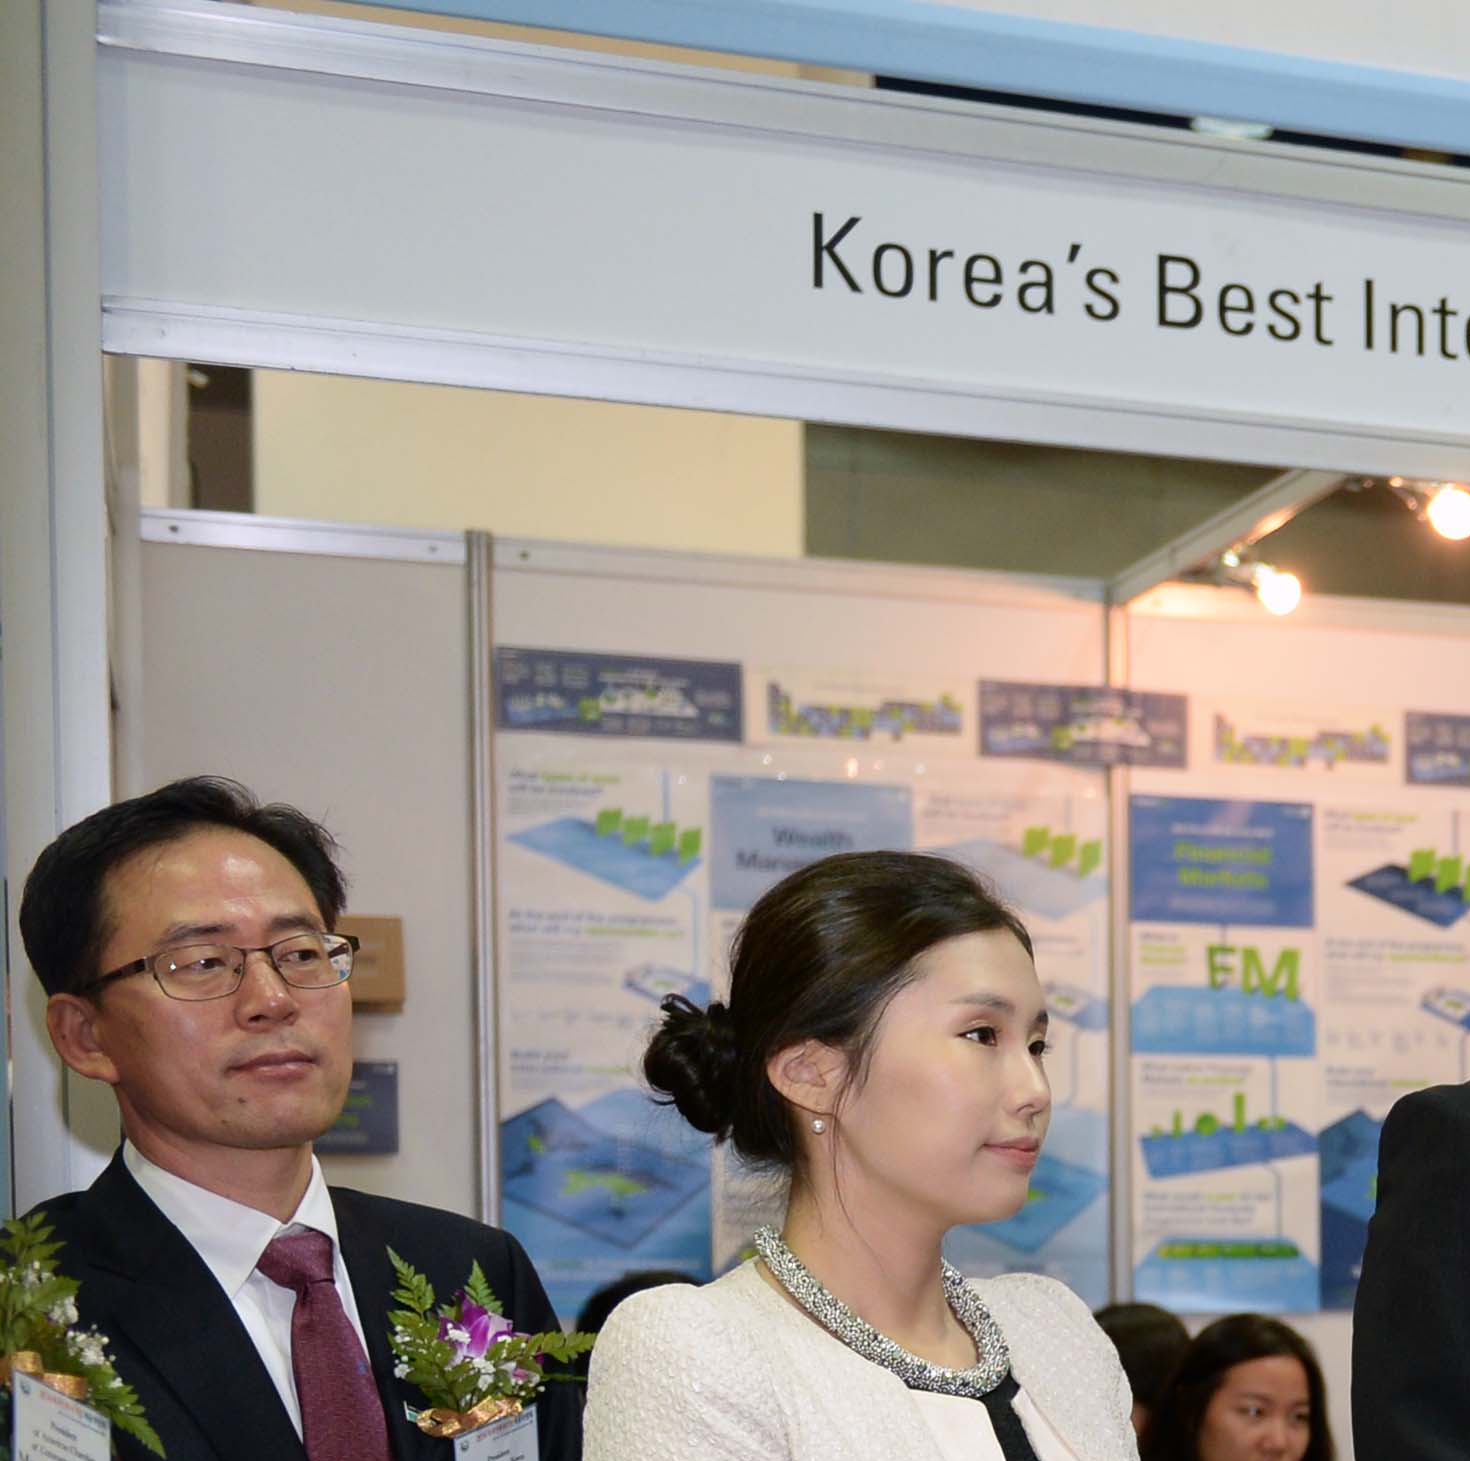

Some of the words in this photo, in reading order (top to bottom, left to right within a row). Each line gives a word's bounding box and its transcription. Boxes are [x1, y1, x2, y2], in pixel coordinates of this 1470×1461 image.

[810, 212, 1120, 323] Korea's
[1156, 253, 1335, 346] Best
[771, 825, 854, 849] Wealth
[1173, 841, 1273, 866] Financial
[1178, 866, 1271, 891] Markets
[1205, 942, 1302, 1000] FM
